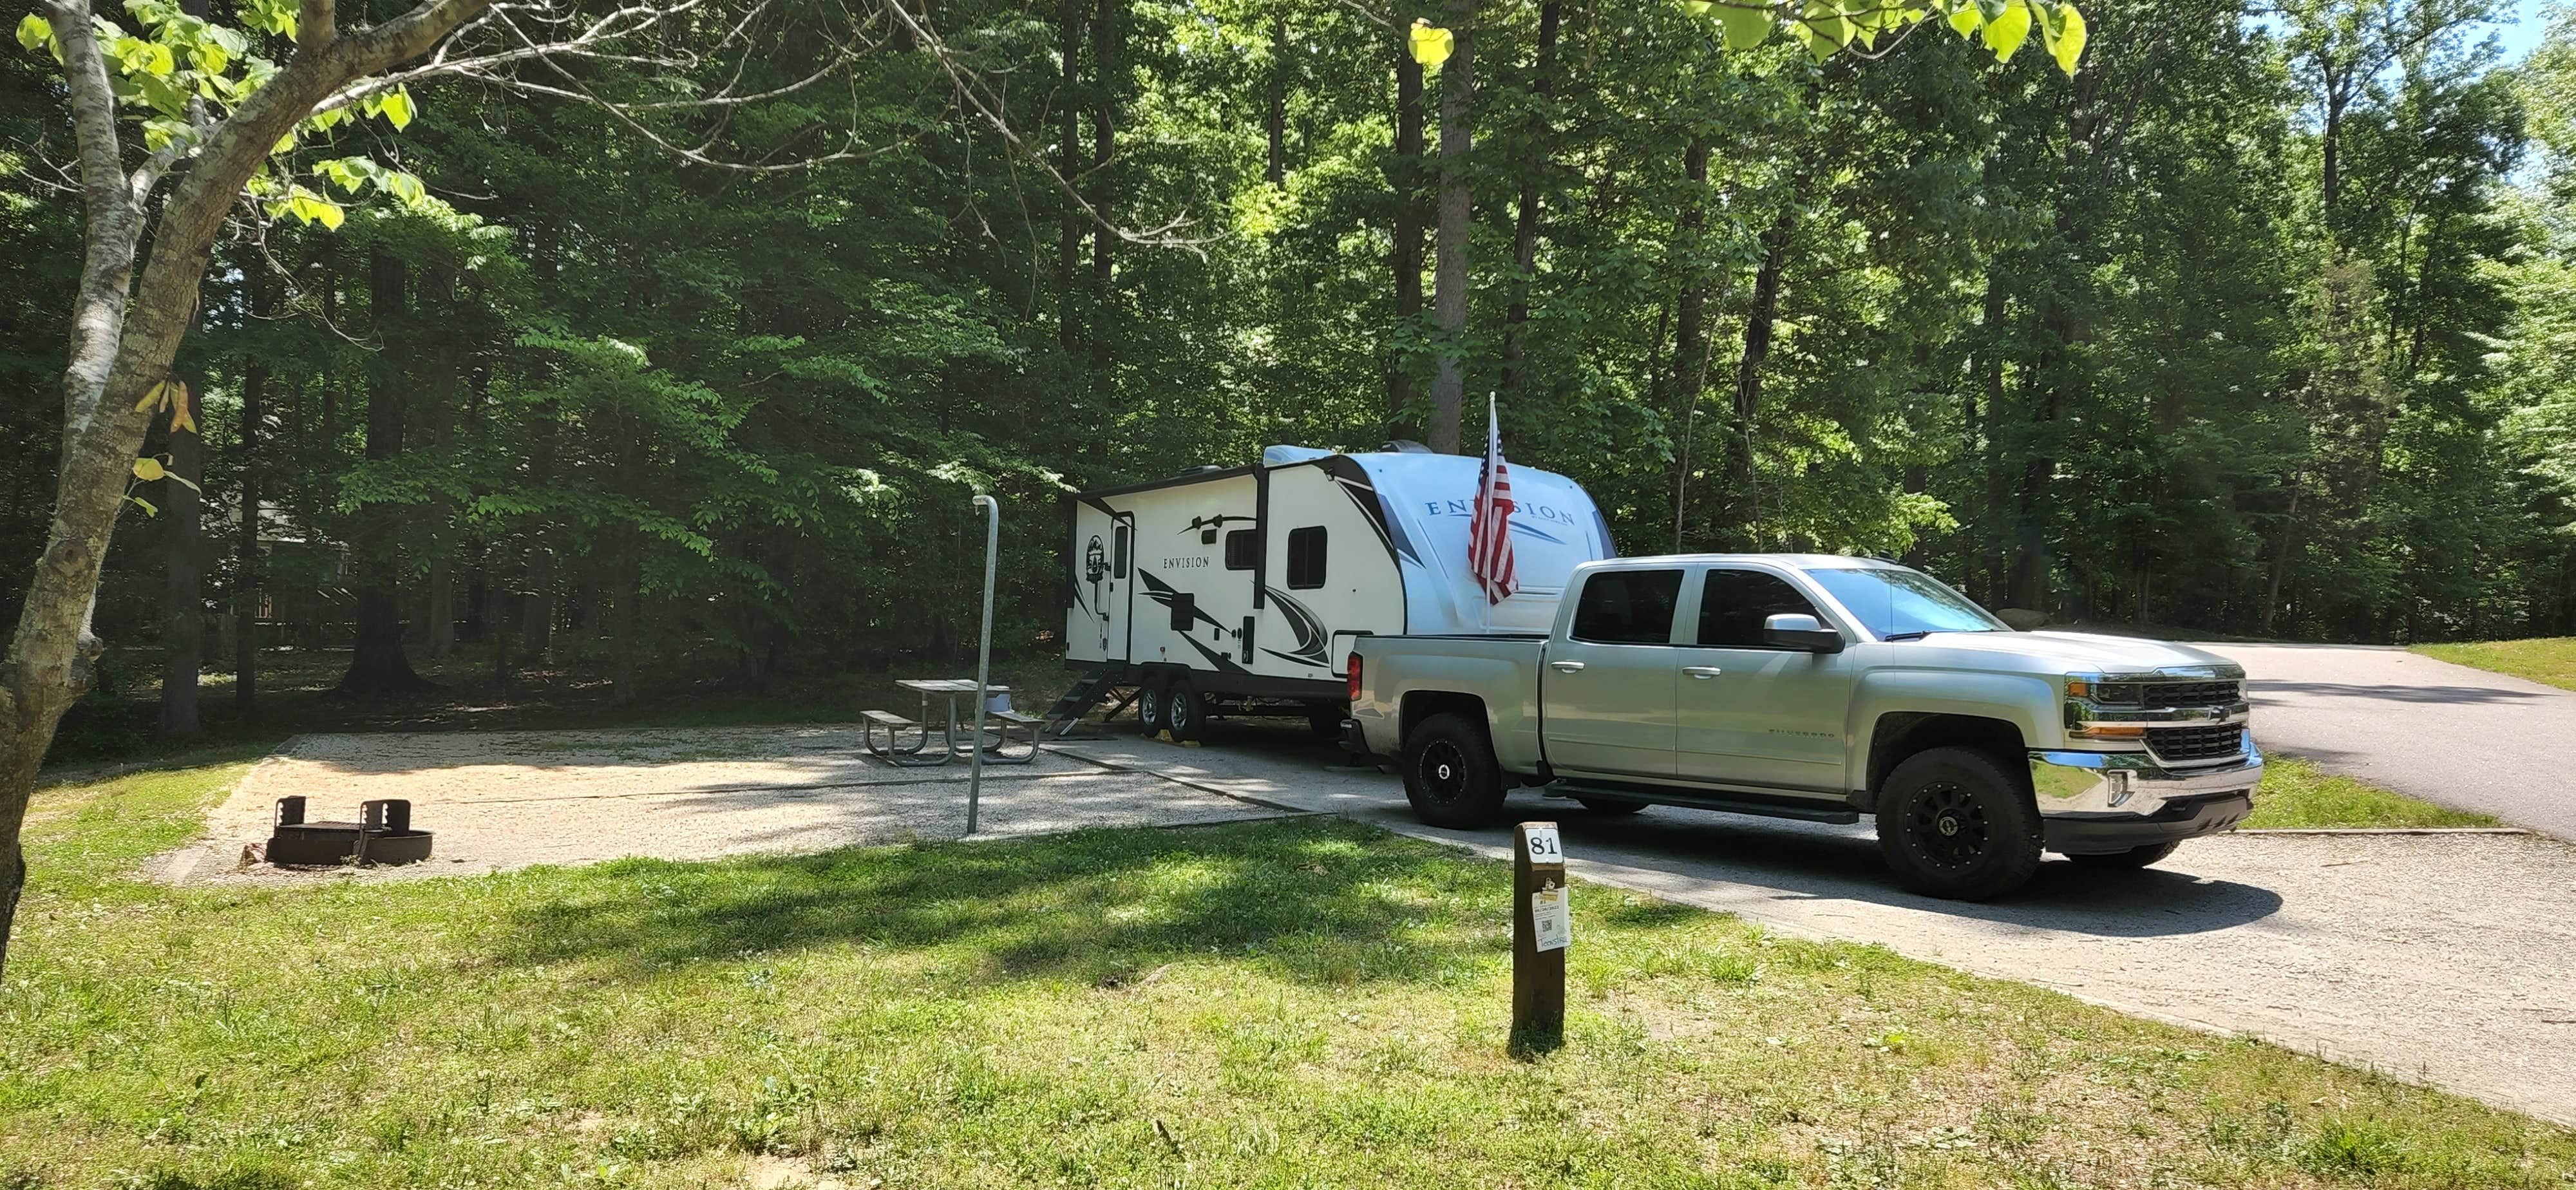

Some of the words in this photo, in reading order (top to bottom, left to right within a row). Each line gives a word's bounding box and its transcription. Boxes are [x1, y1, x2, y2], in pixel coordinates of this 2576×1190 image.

[1425, 499, 1575, 525] ENSION
[1164, 556, 1209, 569] ENVISION
[1530, 836, 1558, 855] 81
